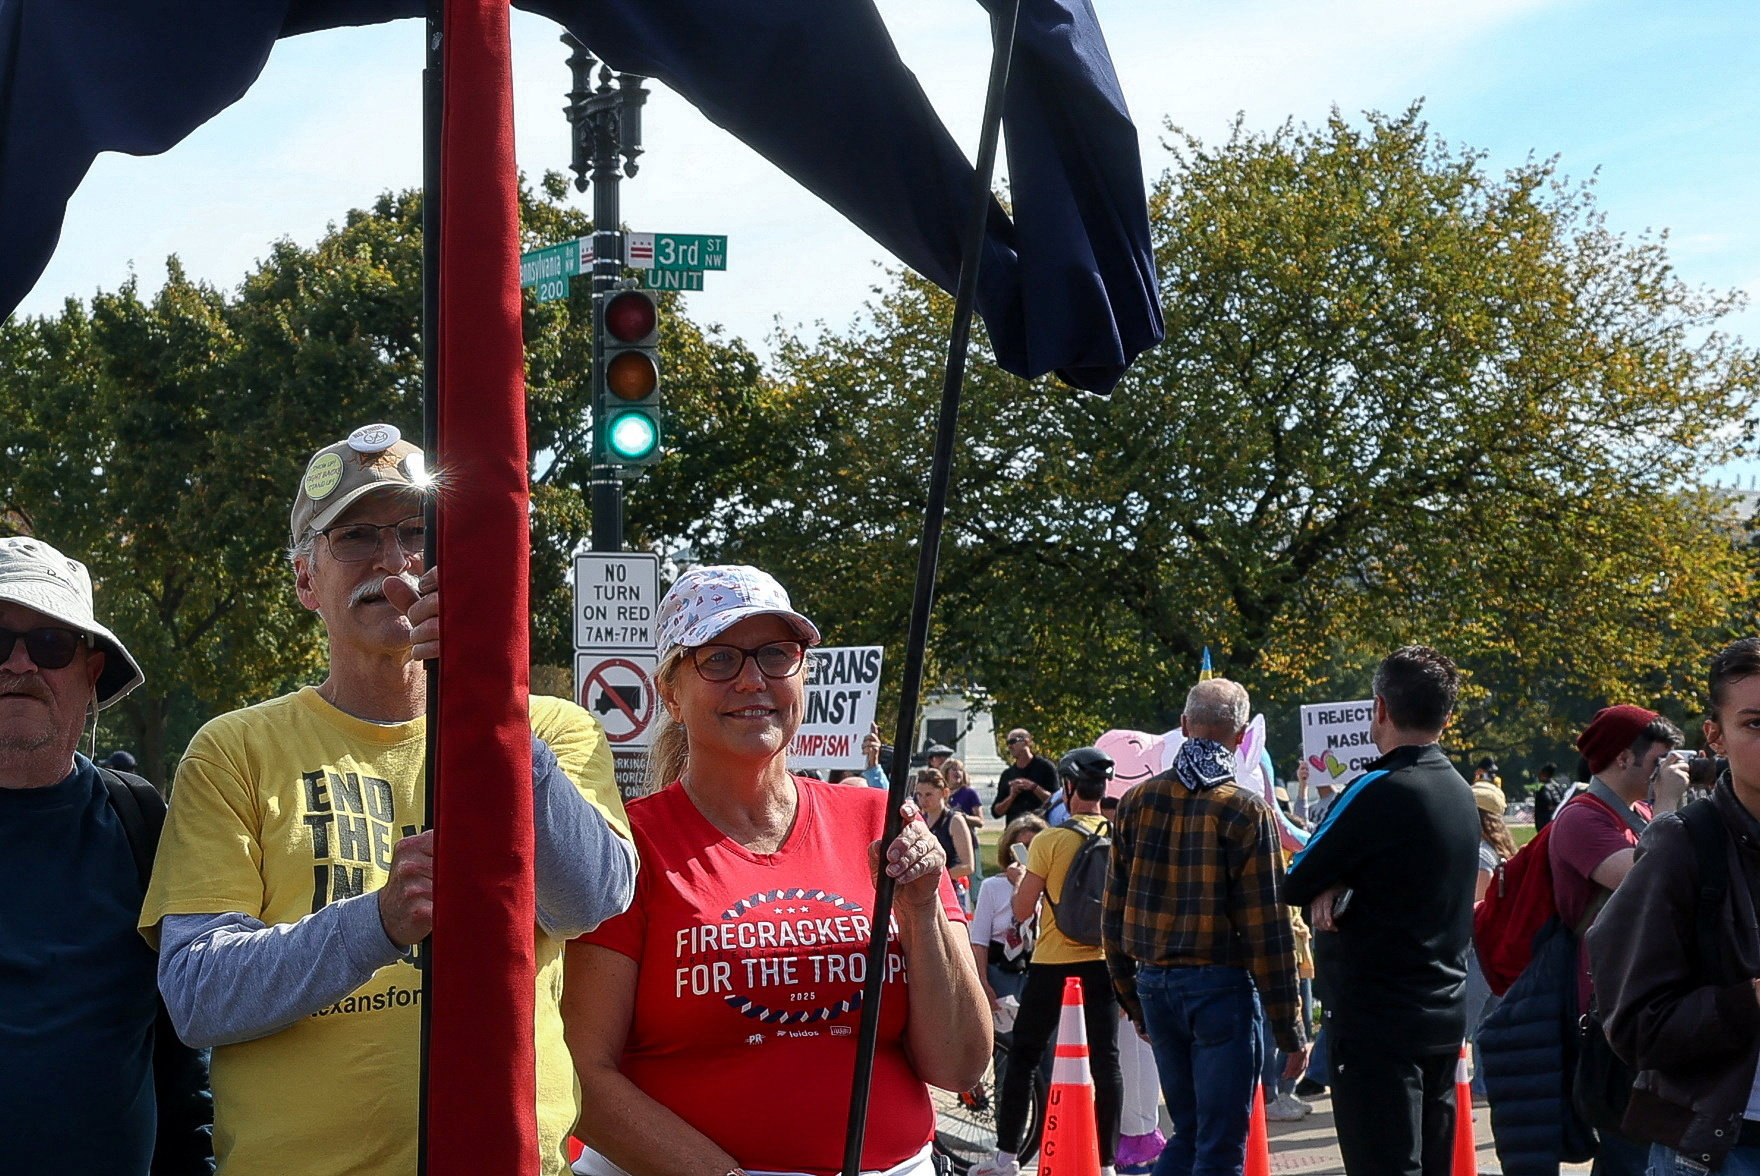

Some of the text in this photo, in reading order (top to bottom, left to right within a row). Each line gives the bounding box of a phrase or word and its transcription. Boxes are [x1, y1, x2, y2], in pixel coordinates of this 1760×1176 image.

[659, 238, 721, 266] 3rd ST
[705, 254, 723, 266] NW
[520, 248, 561, 292] nnsylvania
[648, 270, 702, 290] UNIT
[541, 280, 564, 300] 200
[605, 564, 626, 582] NO
[593, 585, 640, 601] TURN
[583, 605, 650, 621] ON RED
[585, 626, 649, 642] 7AM-7PM
[805, 649, 880, 685] ERANS
[801, 690, 862, 725] INST
[1308, 708, 1373, 726] I REJECT
[1327, 731, 1374, 749] MASK
[615, 758, 647, 770] RKING
[302, 769, 394, 823] END
[303, 812, 392, 871] THE
[312, 864, 363, 912] IN
[676, 915, 872, 958] FIRECRACKER
[676, 952, 908, 998] FOR THE TROP
[790, 992, 816, 1002] 2025
[789, 1030, 819, 1038] leidos
